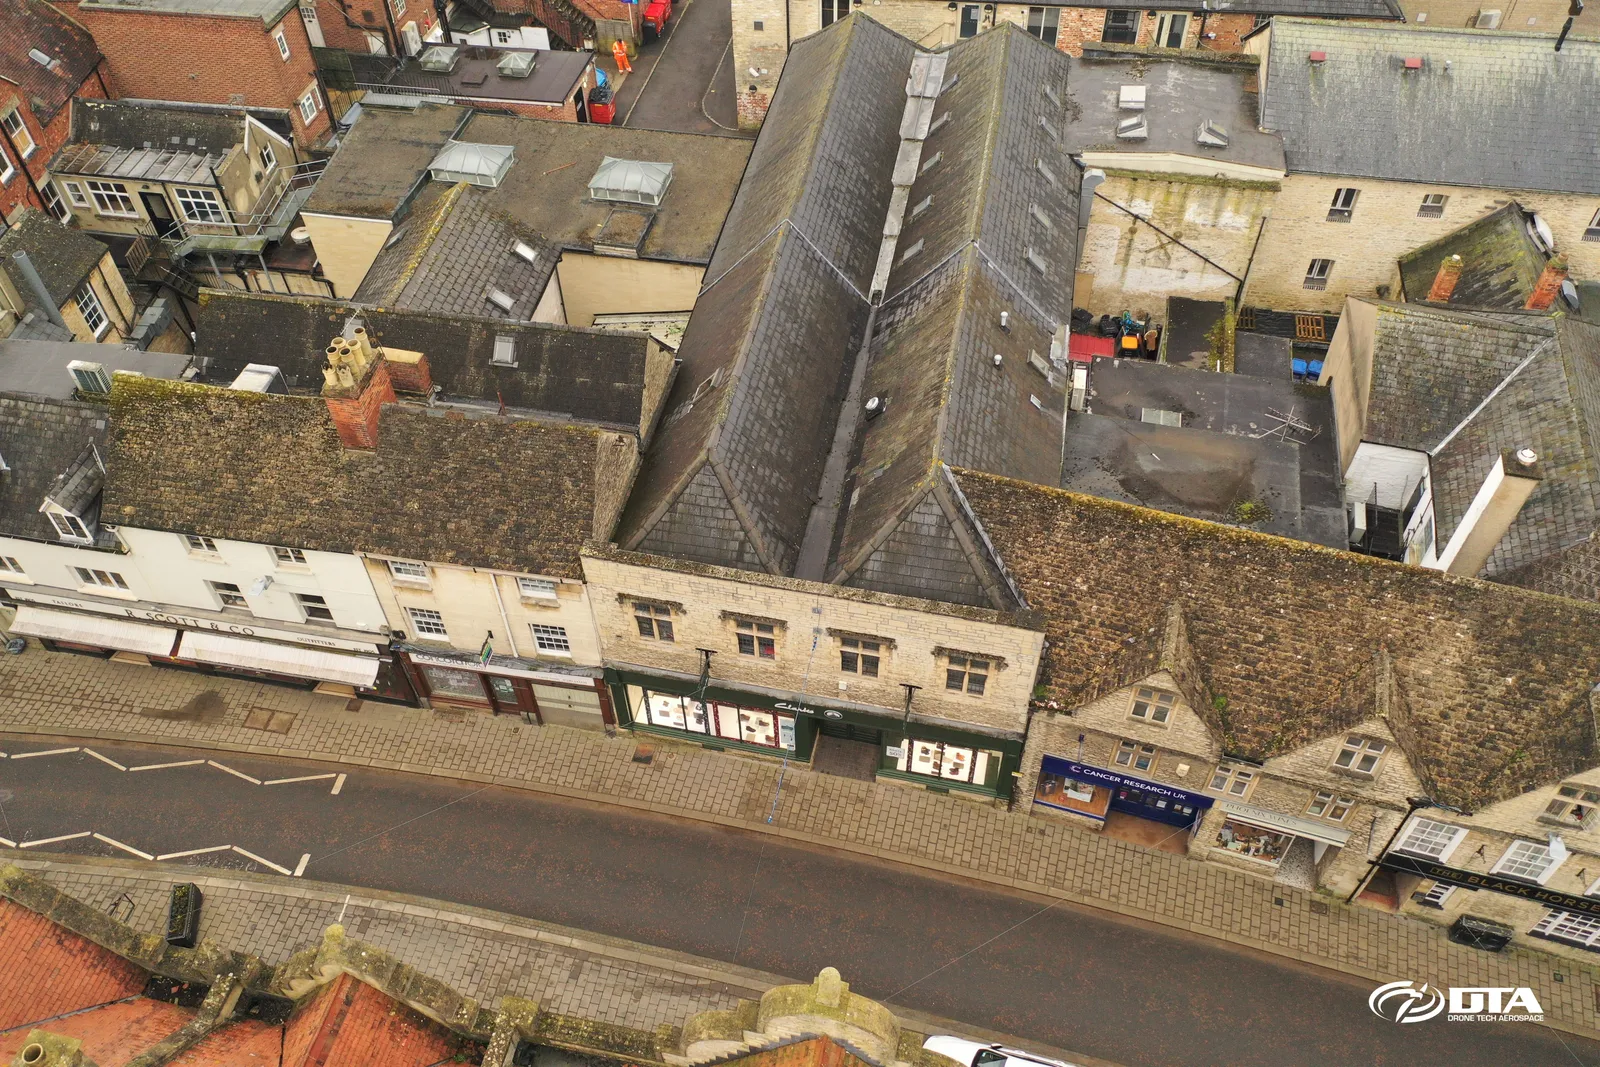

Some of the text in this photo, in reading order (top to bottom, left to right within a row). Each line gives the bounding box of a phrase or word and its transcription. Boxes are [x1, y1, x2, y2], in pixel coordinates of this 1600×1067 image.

[52, 599, 83, 608] TAILORS
[146, 612, 199, 628] SCOTT
[210, 622, 219, 631] &
[229, 625, 255, 636] CO
[296, 636, 336, 646] OUTFITTERS
[774, 702, 815, 714] Clarks
[1083, 769, 1121, 783] CANCER
[1123, 779, 1171, 796] RESEARCH
[1172, 791, 1187, 800] UK
[1225, 803, 1297, 826] PHOENIX WINES
[1433, 868, 1600, 912] THE BLACK HORSE
